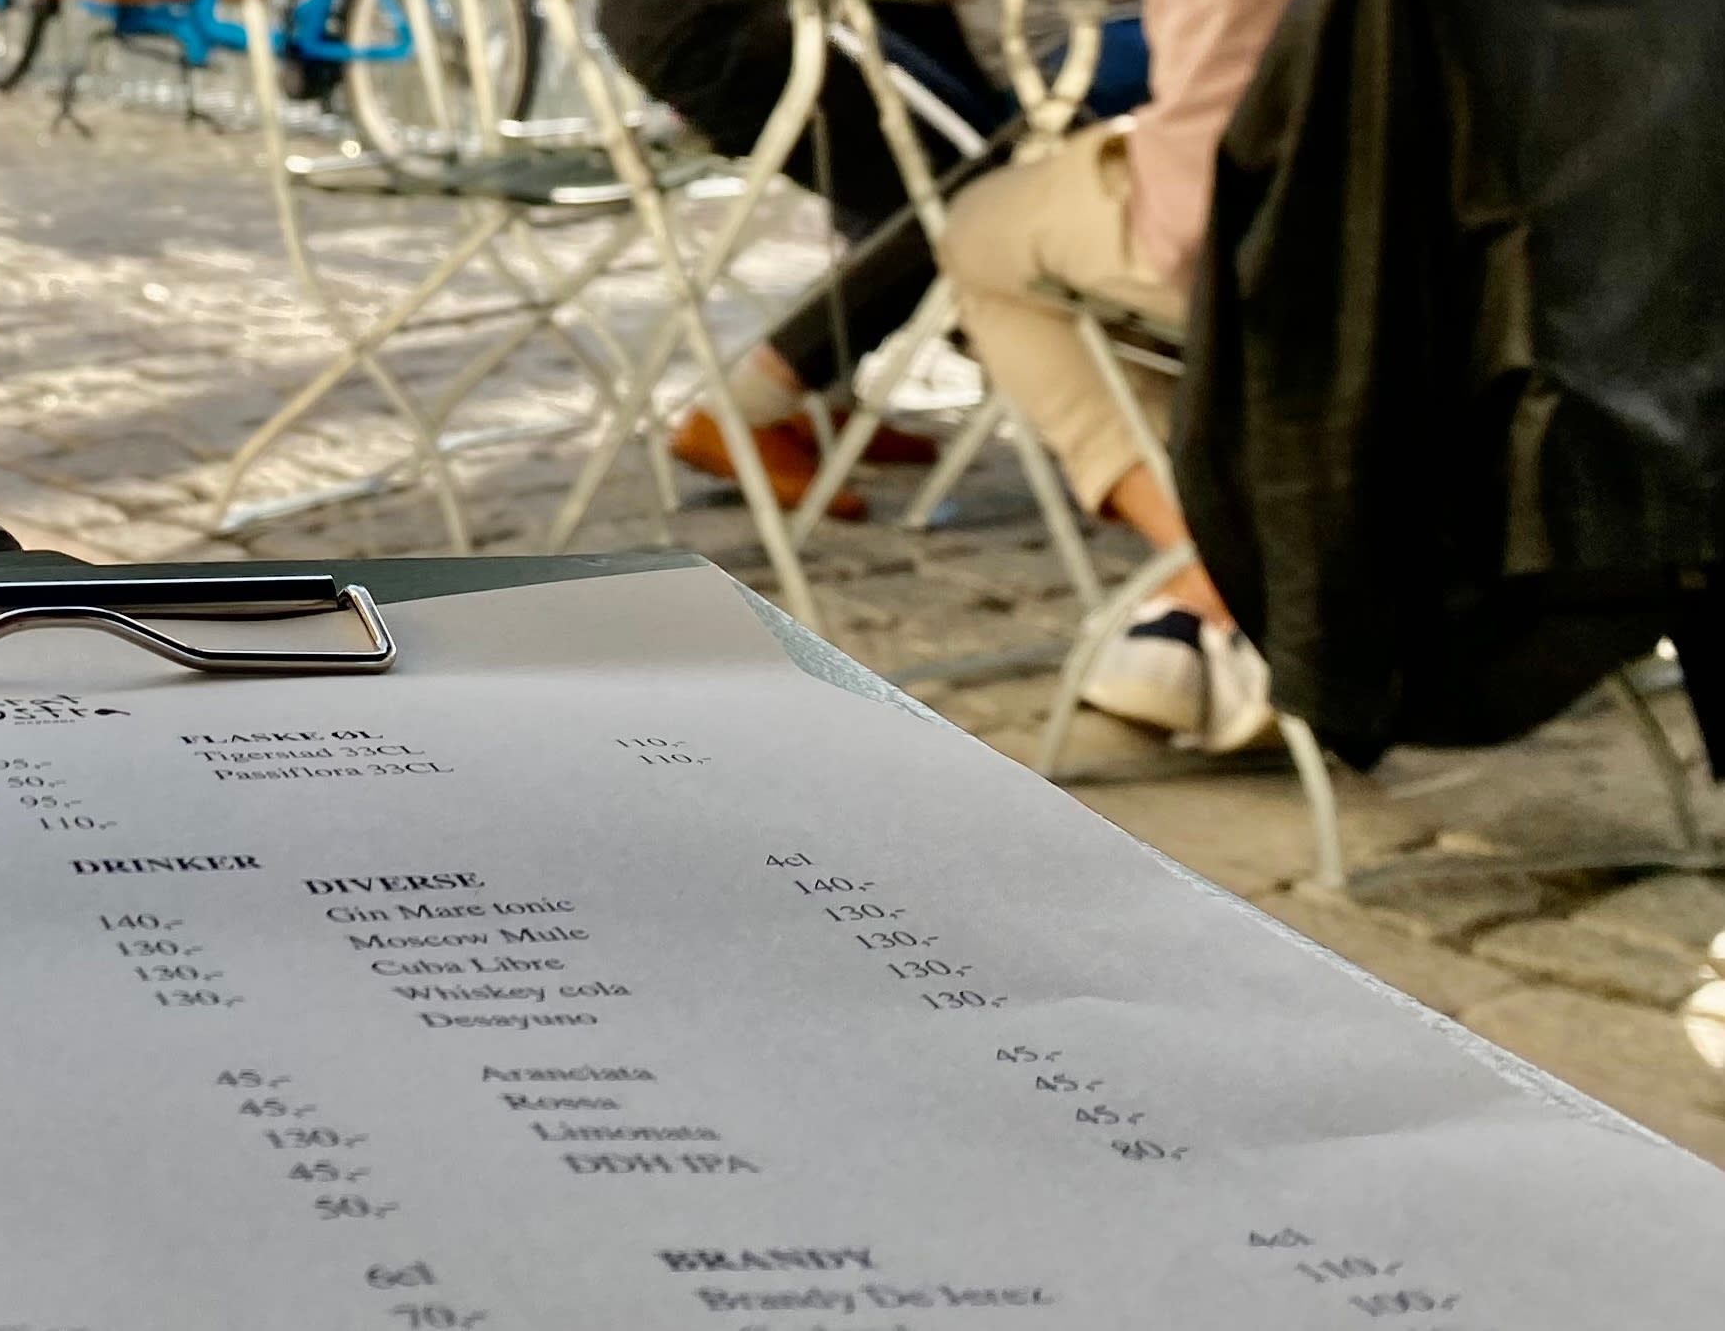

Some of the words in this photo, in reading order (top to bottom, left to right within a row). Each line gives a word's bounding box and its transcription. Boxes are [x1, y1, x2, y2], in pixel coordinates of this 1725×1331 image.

[180, 732, 324, 744] FLASKE
[194, 748, 334, 763] Tigerstad
[339, 745, 425, 757] 33CL
[214, 762, 363, 780] Passiflora
[367, 762, 454, 775] 33CL
[72, 856, 261, 874] DRINKER
[766, 853, 814, 867] 4cl
[304, 873, 485, 895] DIVERSE
[794, 877, 875, 896] 140,-
[326, 906, 390, 923] Gin
[395, 904, 486, 920] Mare
[492, 897, 575, 915] tonic
[823, 904, 905, 922] 130,-
[347, 933, 488, 950] Moscow
[498, 926, 589, 944] Mule
[855, 931, 939, 949] 130,-
[371, 958, 465, 976] Cuba
[470, 955, 565, 973] Libre
[887, 960, 973, 980] 130,-
[392, 982, 547, 1002] Whiskey
[559, 980, 632, 998] cola
[920, 990, 1008, 1010] 130,-
[417, 1010, 598, 1031] Desayuno
[653, 1247, 877, 1272] BRANDY
